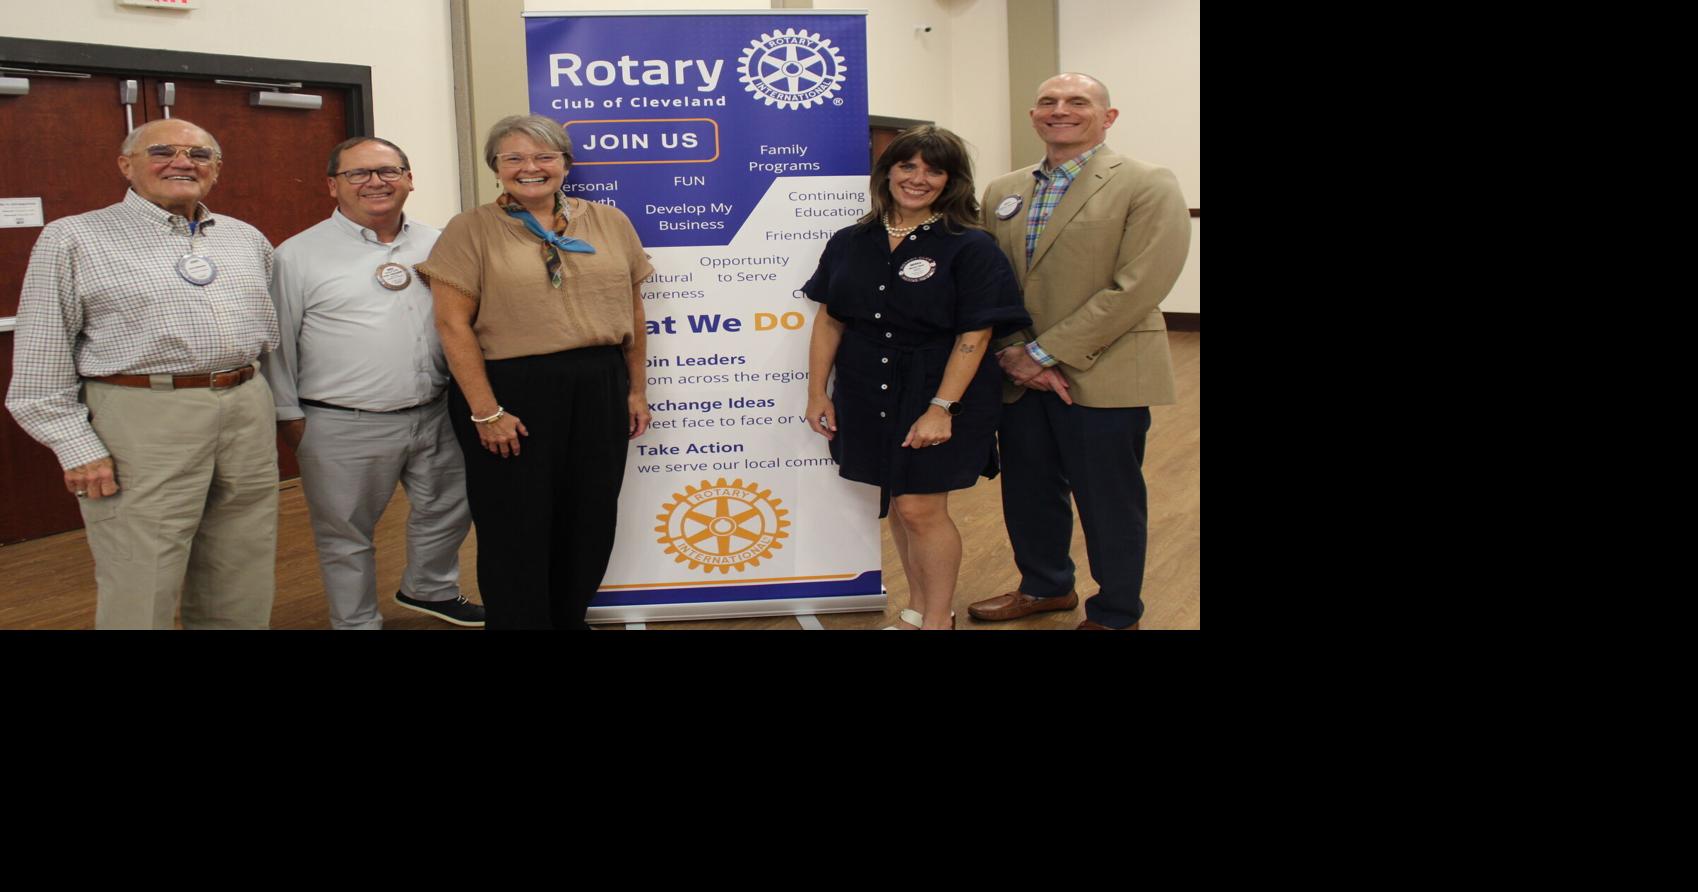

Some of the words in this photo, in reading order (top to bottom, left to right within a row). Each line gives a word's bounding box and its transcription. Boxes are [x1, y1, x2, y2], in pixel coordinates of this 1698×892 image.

[768, 36, 815, 48] ROTARY
[549, 52, 724, 92] Rotary
[755, 79, 832, 102] INTERNATIONAL
[551, 97, 595, 109] Club
[603, 97, 623, 108] of
[630, 95, 726, 108] Cleveland
[582, 133, 649, 150] JOIN
[661, 132, 699, 149] US
[760, 144, 808, 156] Family
[749, 160, 821, 174] Programs
[562, 180, 618, 192] ersonal
[674, 176, 705, 187] FUN
[788, 191, 866, 203] Continuing
[645, 203, 706, 217] Develop
[711, 203, 733, 214] My
[795, 207, 865, 218] Education
[659, 220, 724, 231] Business
[699, 255, 790, 269] Opportunity
[645, 272, 693, 284] ultural
[718, 272, 732, 283] to
[736, 271, 777, 283] Serve
[645, 315, 677, 335] at
[687, 313, 742, 334] We
[754, 311, 805, 331] DO
[676, 353, 746, 367] Leaders
[647, 375, 673, 386] om
[678, 374, 729, 384] across
[734, 371, 760, 382] the
[647, 399, 722, 413] xchange
[728, 397, 775, 409] Ideas
[682, 416, 715, 428] face
[720, 416, 736, 427] to
[741, 414, 773, 426] face
[778, 415, 794, 424] or
[637, 443, 680, 456] Take
[686, 441, 744, 454] Action
[637, 464, 660, 474] we
[665, 461, 708, 472] serve
[712, 460, 740, 471] our
[744, 456, 780, 469] local
[693, 488, 750, 503] ROTARY
[678, 534, 772, 565] INTERNATIONAL
